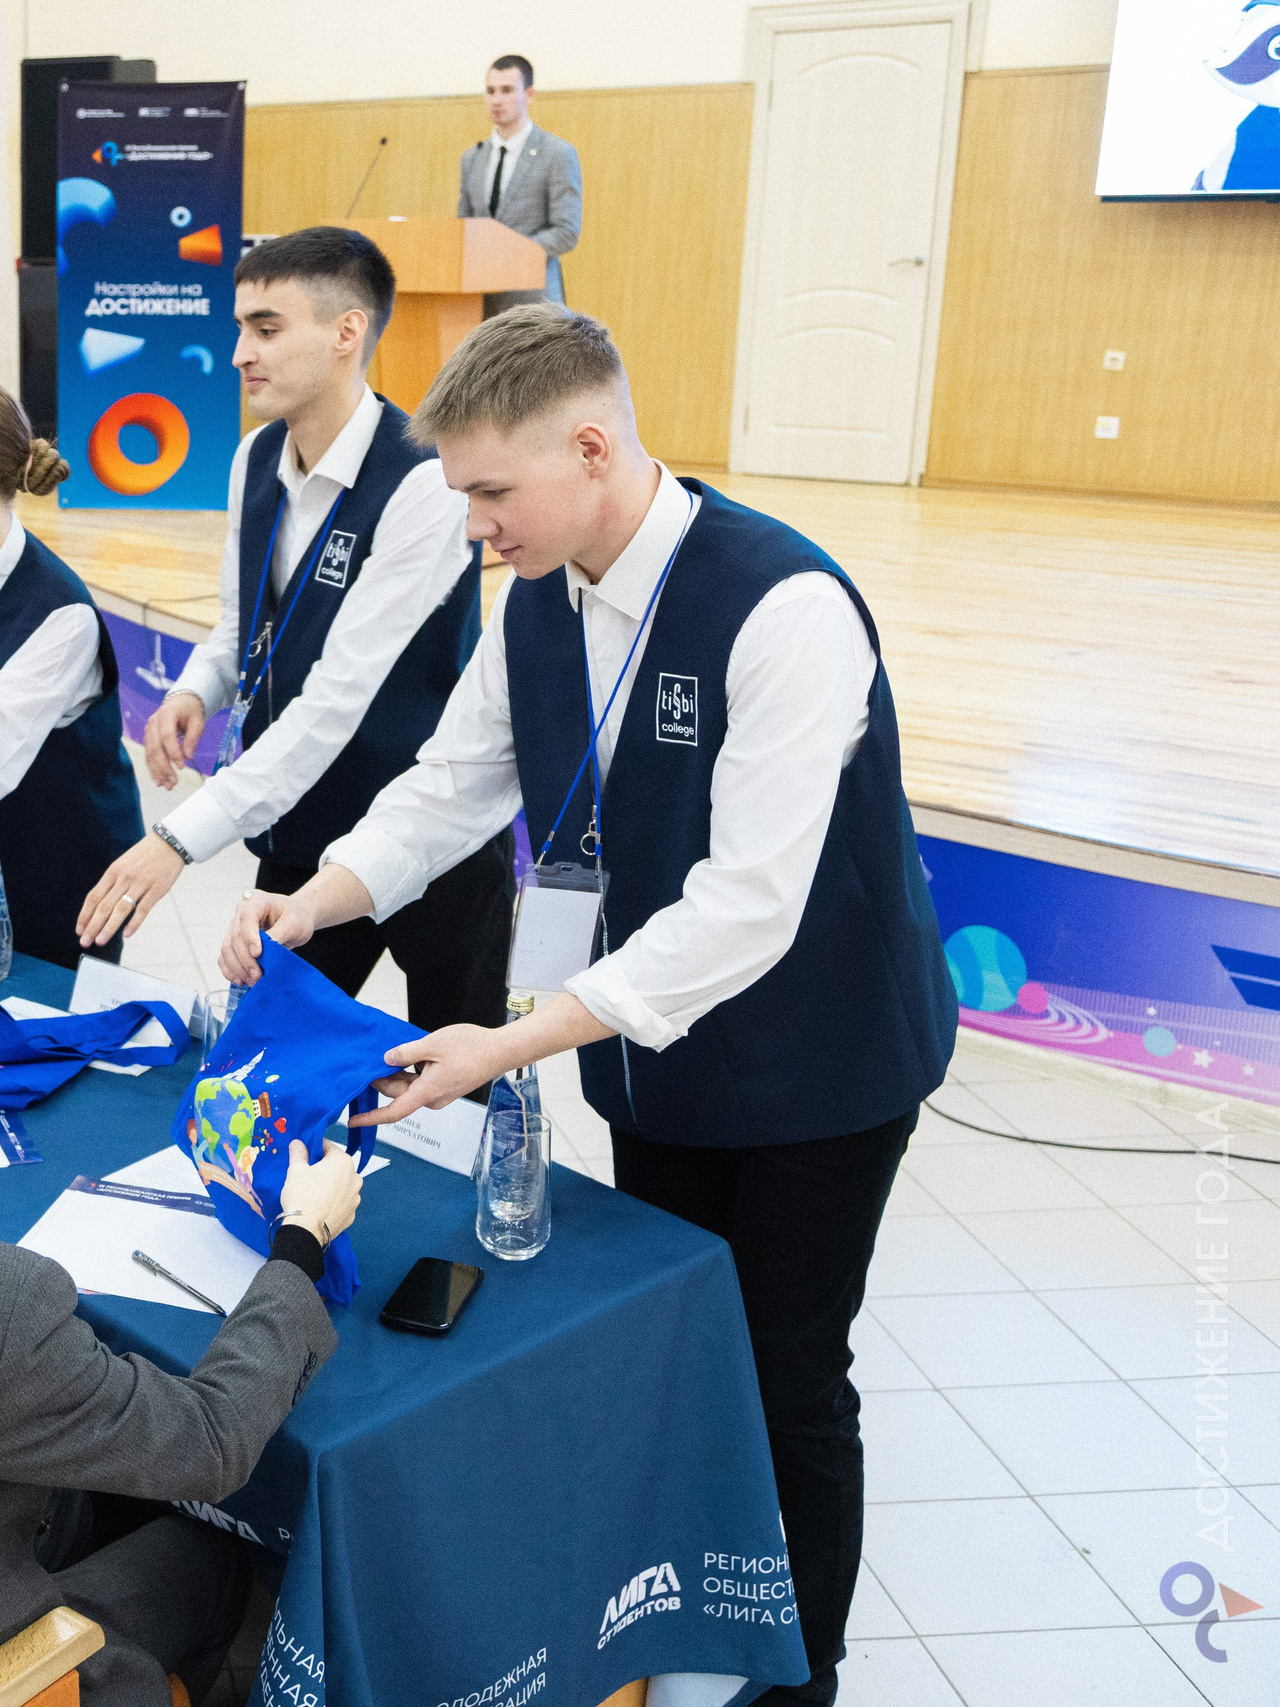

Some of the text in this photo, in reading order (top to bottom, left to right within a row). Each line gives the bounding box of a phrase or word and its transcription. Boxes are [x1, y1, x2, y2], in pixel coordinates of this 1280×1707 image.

[94, 281, 203, 297] Настройки на
[84, 298, 211, 317] ДОСТИЖЕНИЕ
[321, 567, 343, 580] college
[661, 722, 695, 737] college
[704, 1552, 789, 1574] РЕГИОН
[599, 1562, 681, 1634] ЛИГА
[703, 1577, 795, 1602] ОБЩЕСТ
[597, 1597, 681, 1650] СТУДЕНТОВ
[703, 1601, 799, 1625] «ЛИГА СТ
[274, 1597, 325, 1683] ЛЬНАЯ
